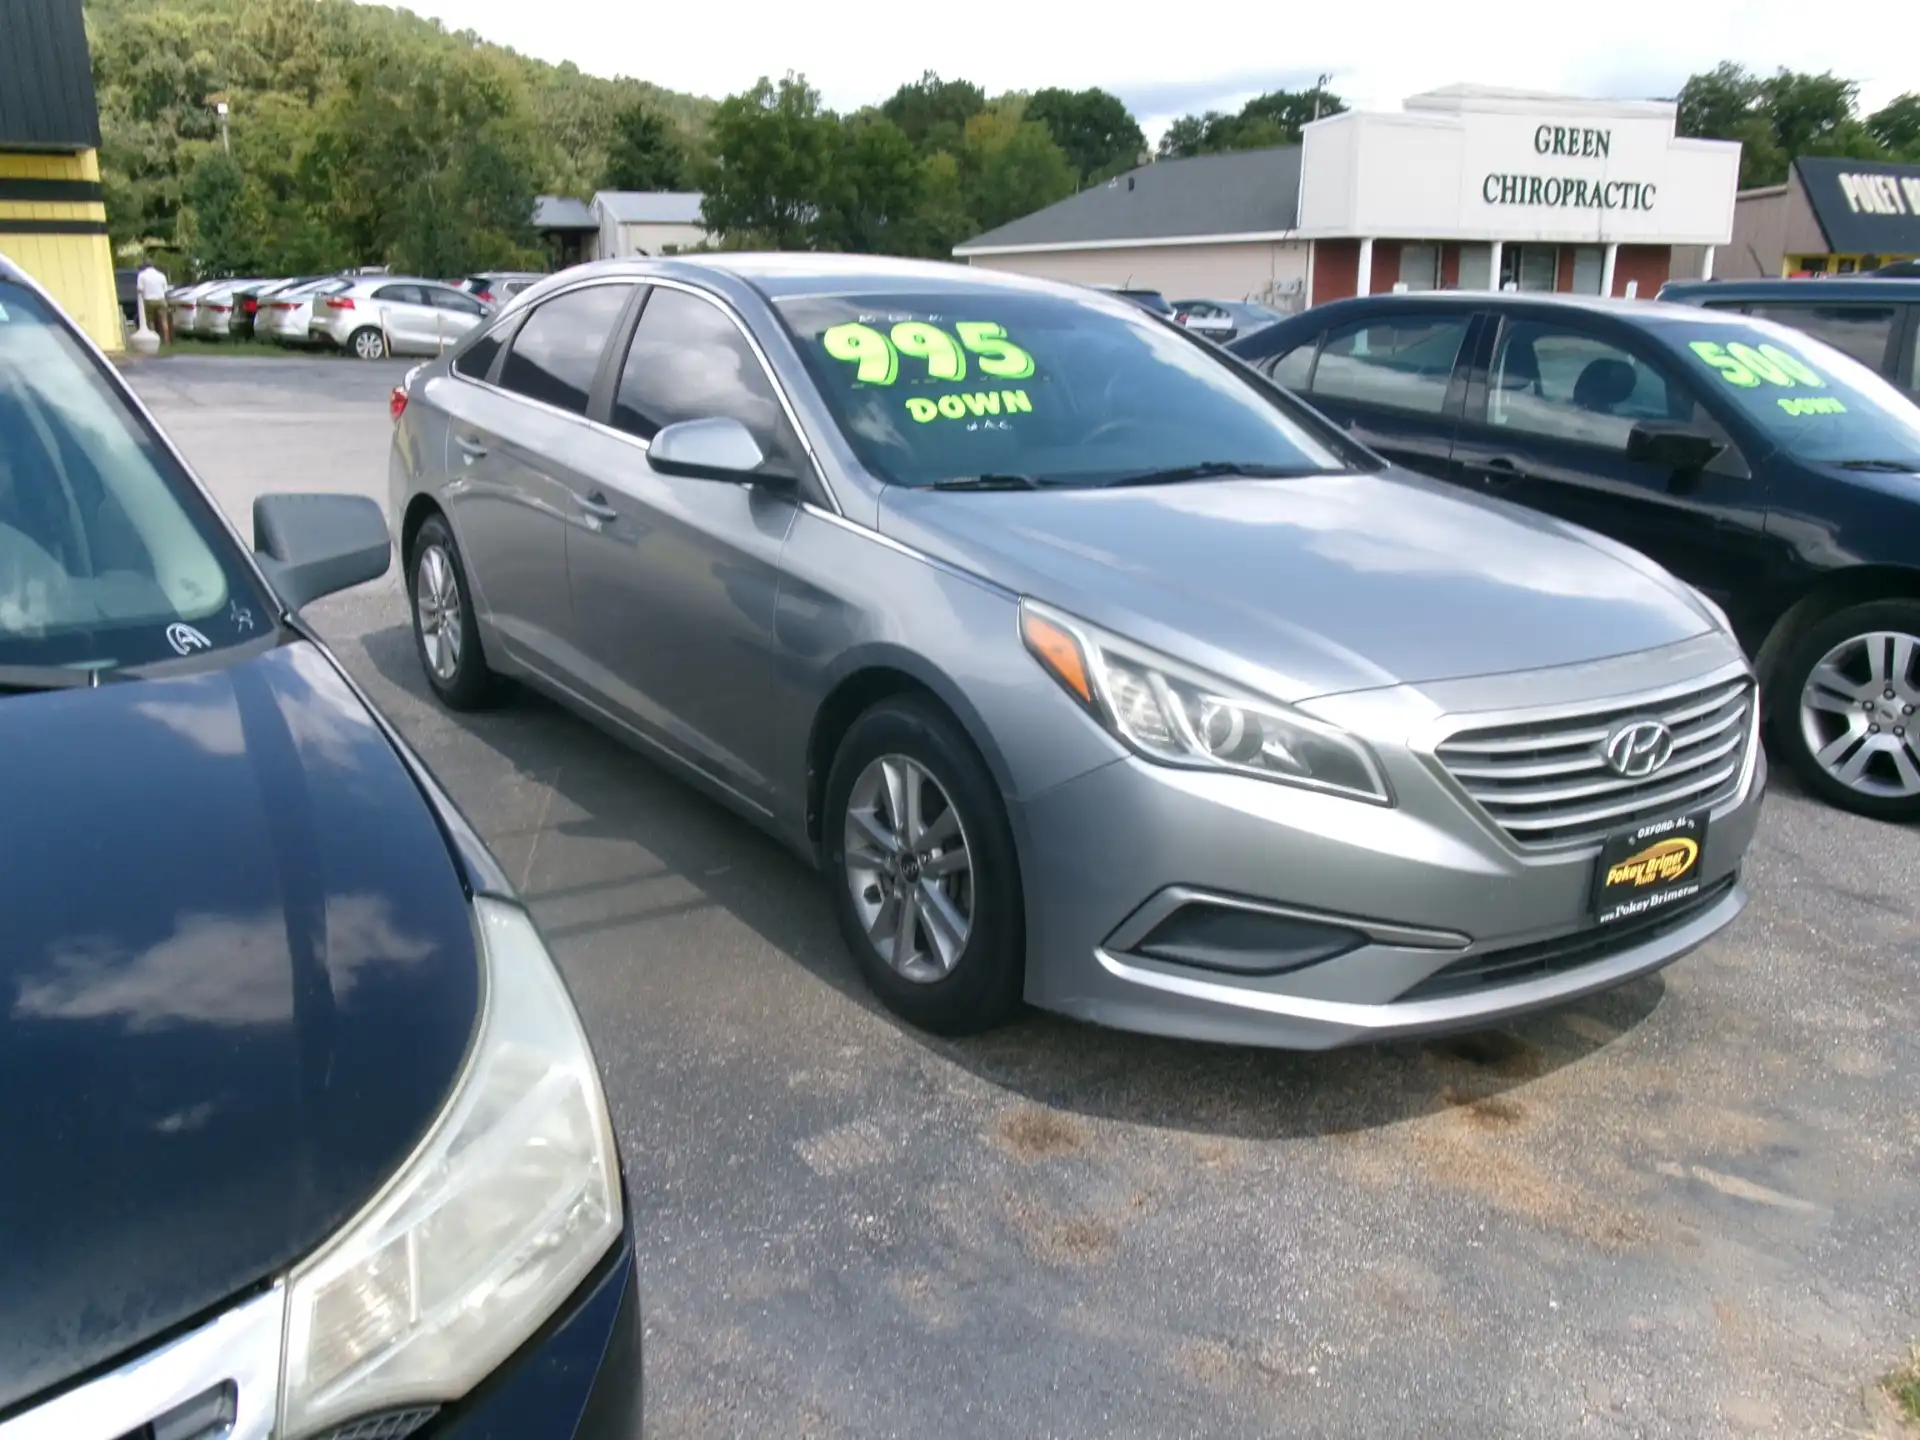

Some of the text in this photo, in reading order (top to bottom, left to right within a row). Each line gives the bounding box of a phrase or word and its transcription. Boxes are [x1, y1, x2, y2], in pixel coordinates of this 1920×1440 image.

[1534, 125, 1611, 159] GREEN
[1483, 172, 1657, 211] CHIROPRACTIC
[823, 322, 1036, 386] 995
[1688, 341, 1827, 388] 500
[904, 390, 1033, 424] DOWN
